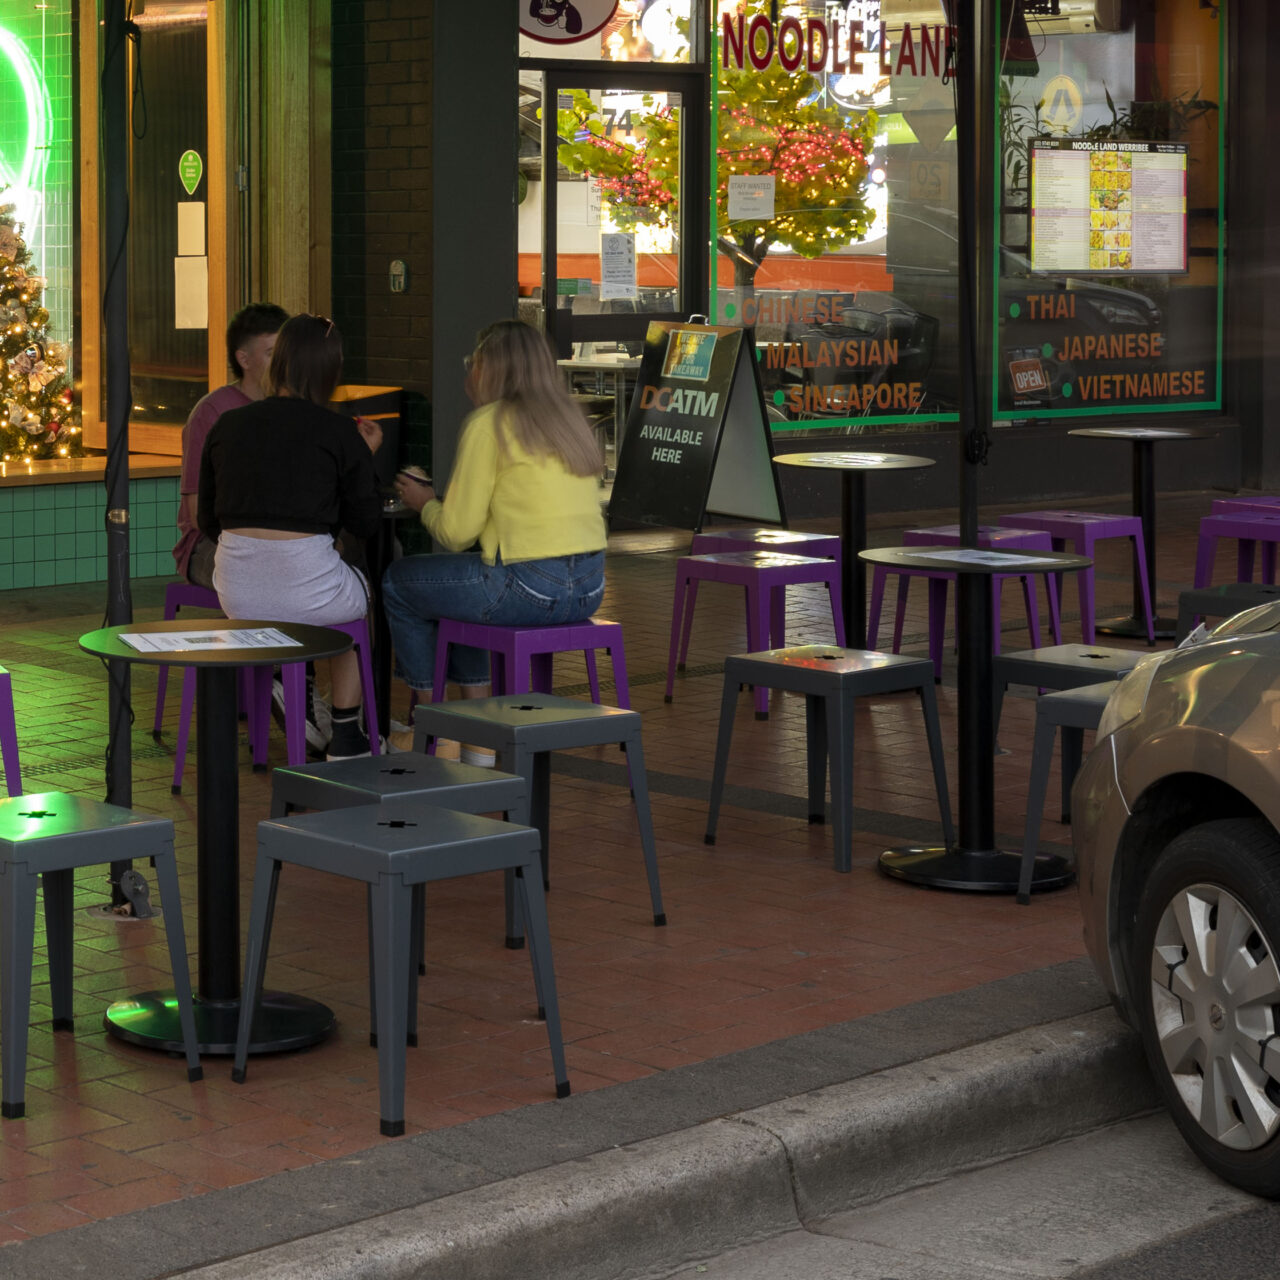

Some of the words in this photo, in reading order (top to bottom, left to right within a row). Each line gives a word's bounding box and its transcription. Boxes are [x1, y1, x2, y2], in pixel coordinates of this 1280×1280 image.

[722, 11, 864, 75] NOODLE
[602, 108, 634, 137] 74
[1072, 141, 1099, 152] NOODLE
[1099, 142, 1118, 152] LAND
[1118, 143, 1149, 152] WERRIBEE
[742, 296, 845, 325] CHINESE
[1026, 293, 1076, 320] THAI
[766, 338, 899, 369] MALAYSIAN
[1058, 332, 1162, 362] JAPANESE
[1015, 369, 1043, 389] OPEN
[1078, 370, 1206, 401] VIETNAMESE
[789, 382, 923, 414] SINGAPORE
[639, 424, 704, 446] AVAILABLE
[651, 446, 683, 464] HERE
